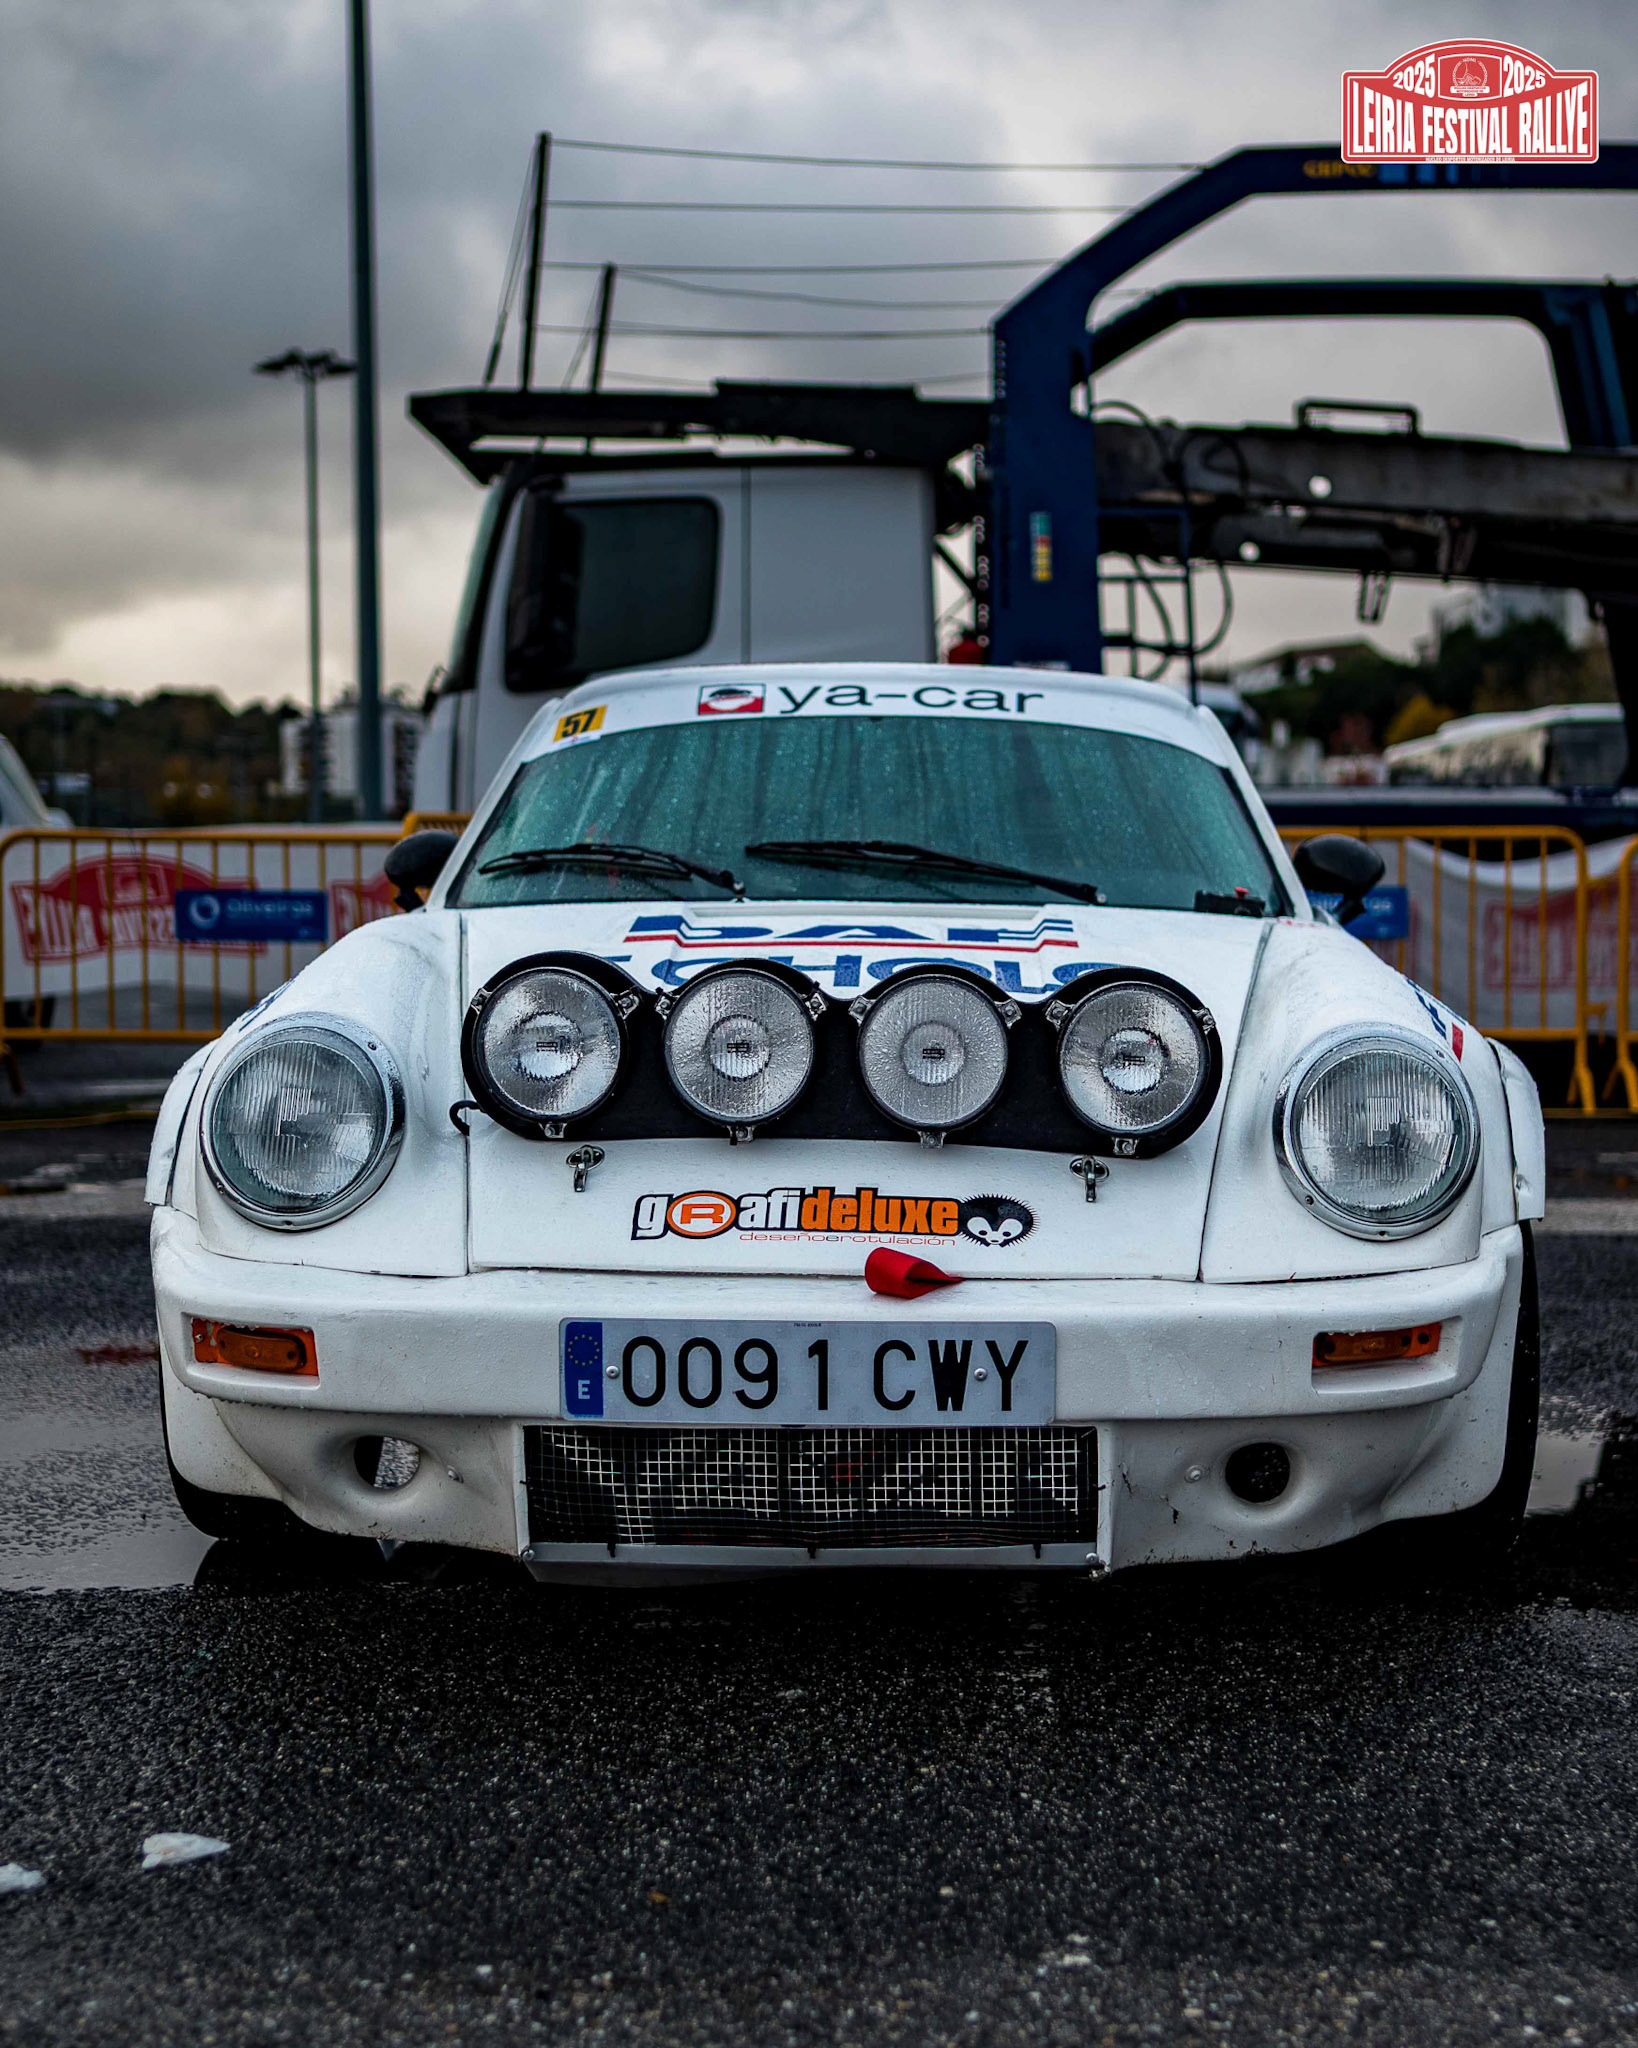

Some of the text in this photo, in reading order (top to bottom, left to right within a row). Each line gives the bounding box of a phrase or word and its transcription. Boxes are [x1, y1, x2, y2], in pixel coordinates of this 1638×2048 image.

[778, 685, 1044, 714] ya-car
[561, 708, 597, 738] 57
[622, 1336, 1029, 1412] 0091 CWY
[577, 1379, 591, 1400] E
